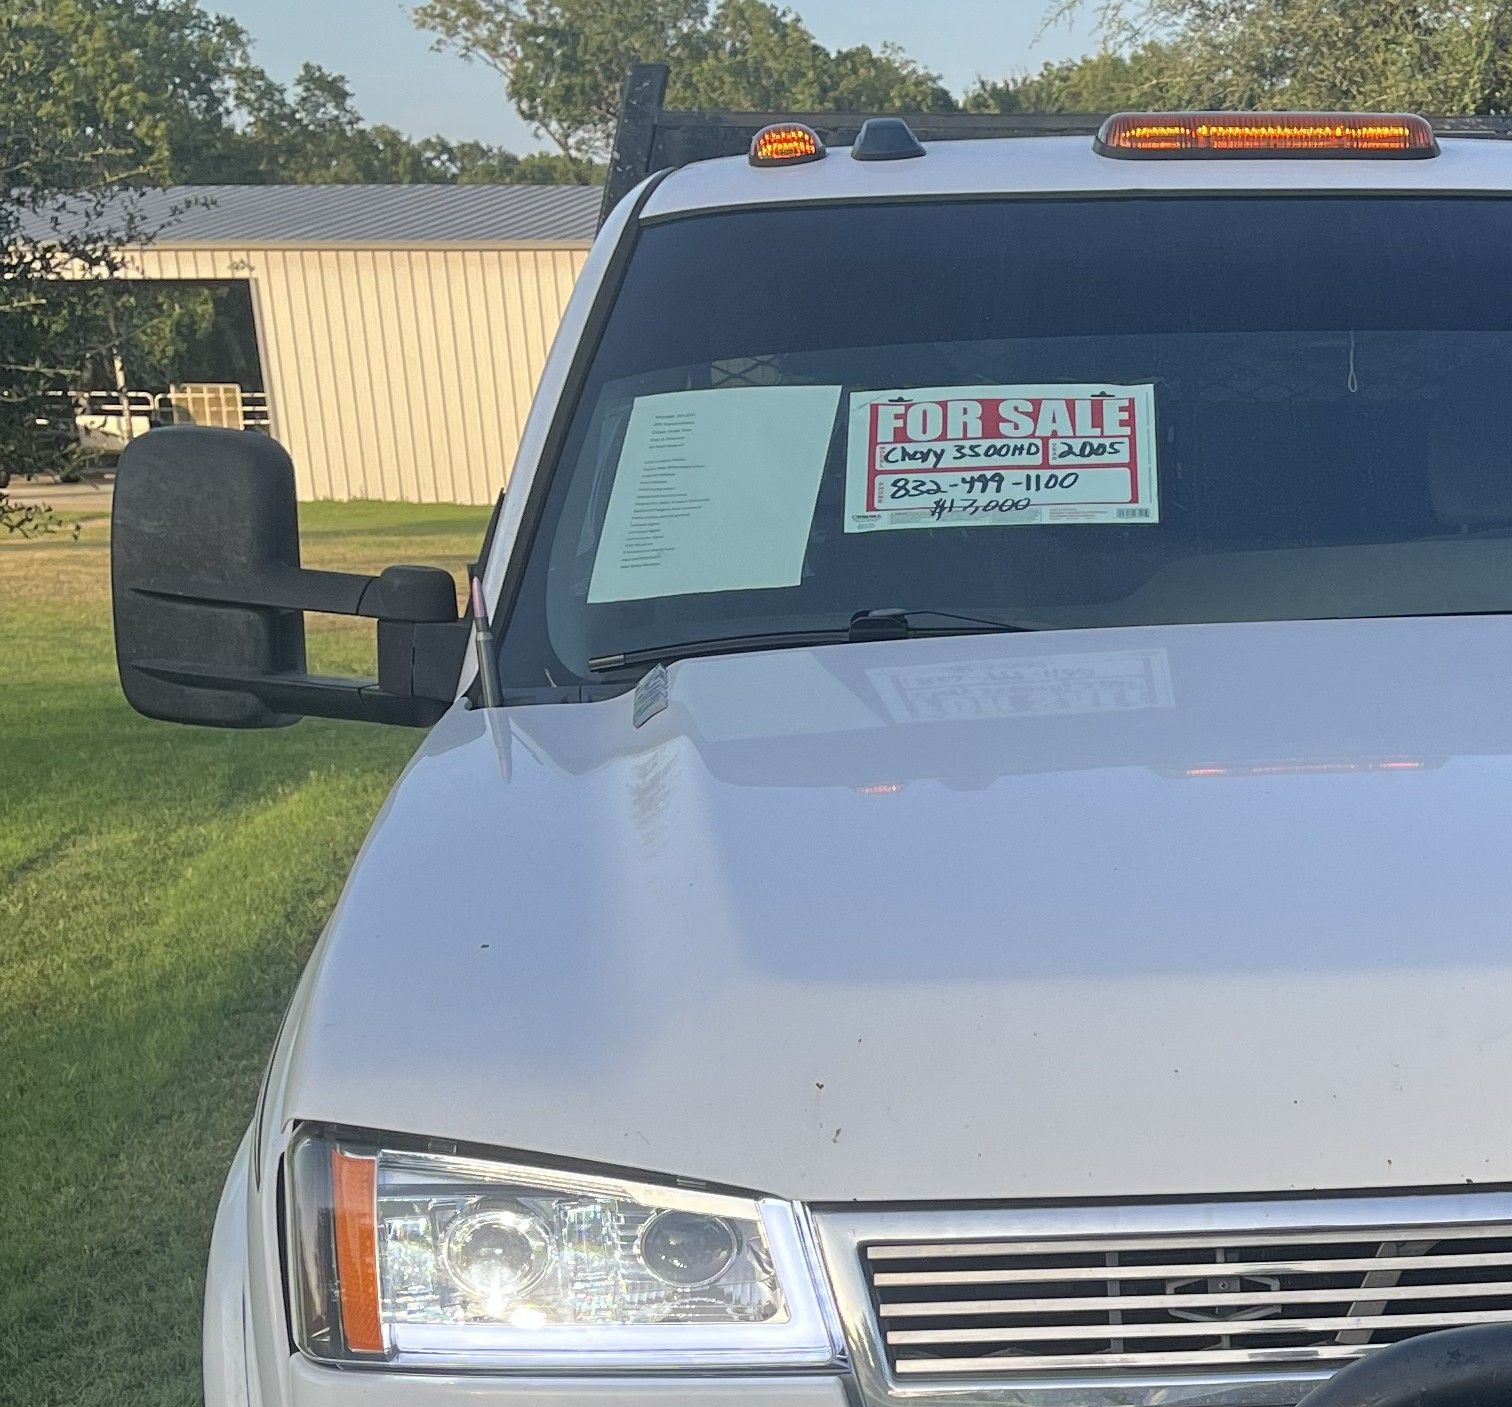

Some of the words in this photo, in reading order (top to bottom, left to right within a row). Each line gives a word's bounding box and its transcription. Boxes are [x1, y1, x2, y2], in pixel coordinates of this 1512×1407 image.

[876, 400, 983, 443] FOR
[999, 399, 1132, 438] SALE
[1058, 441, 1126, 458] 2005
